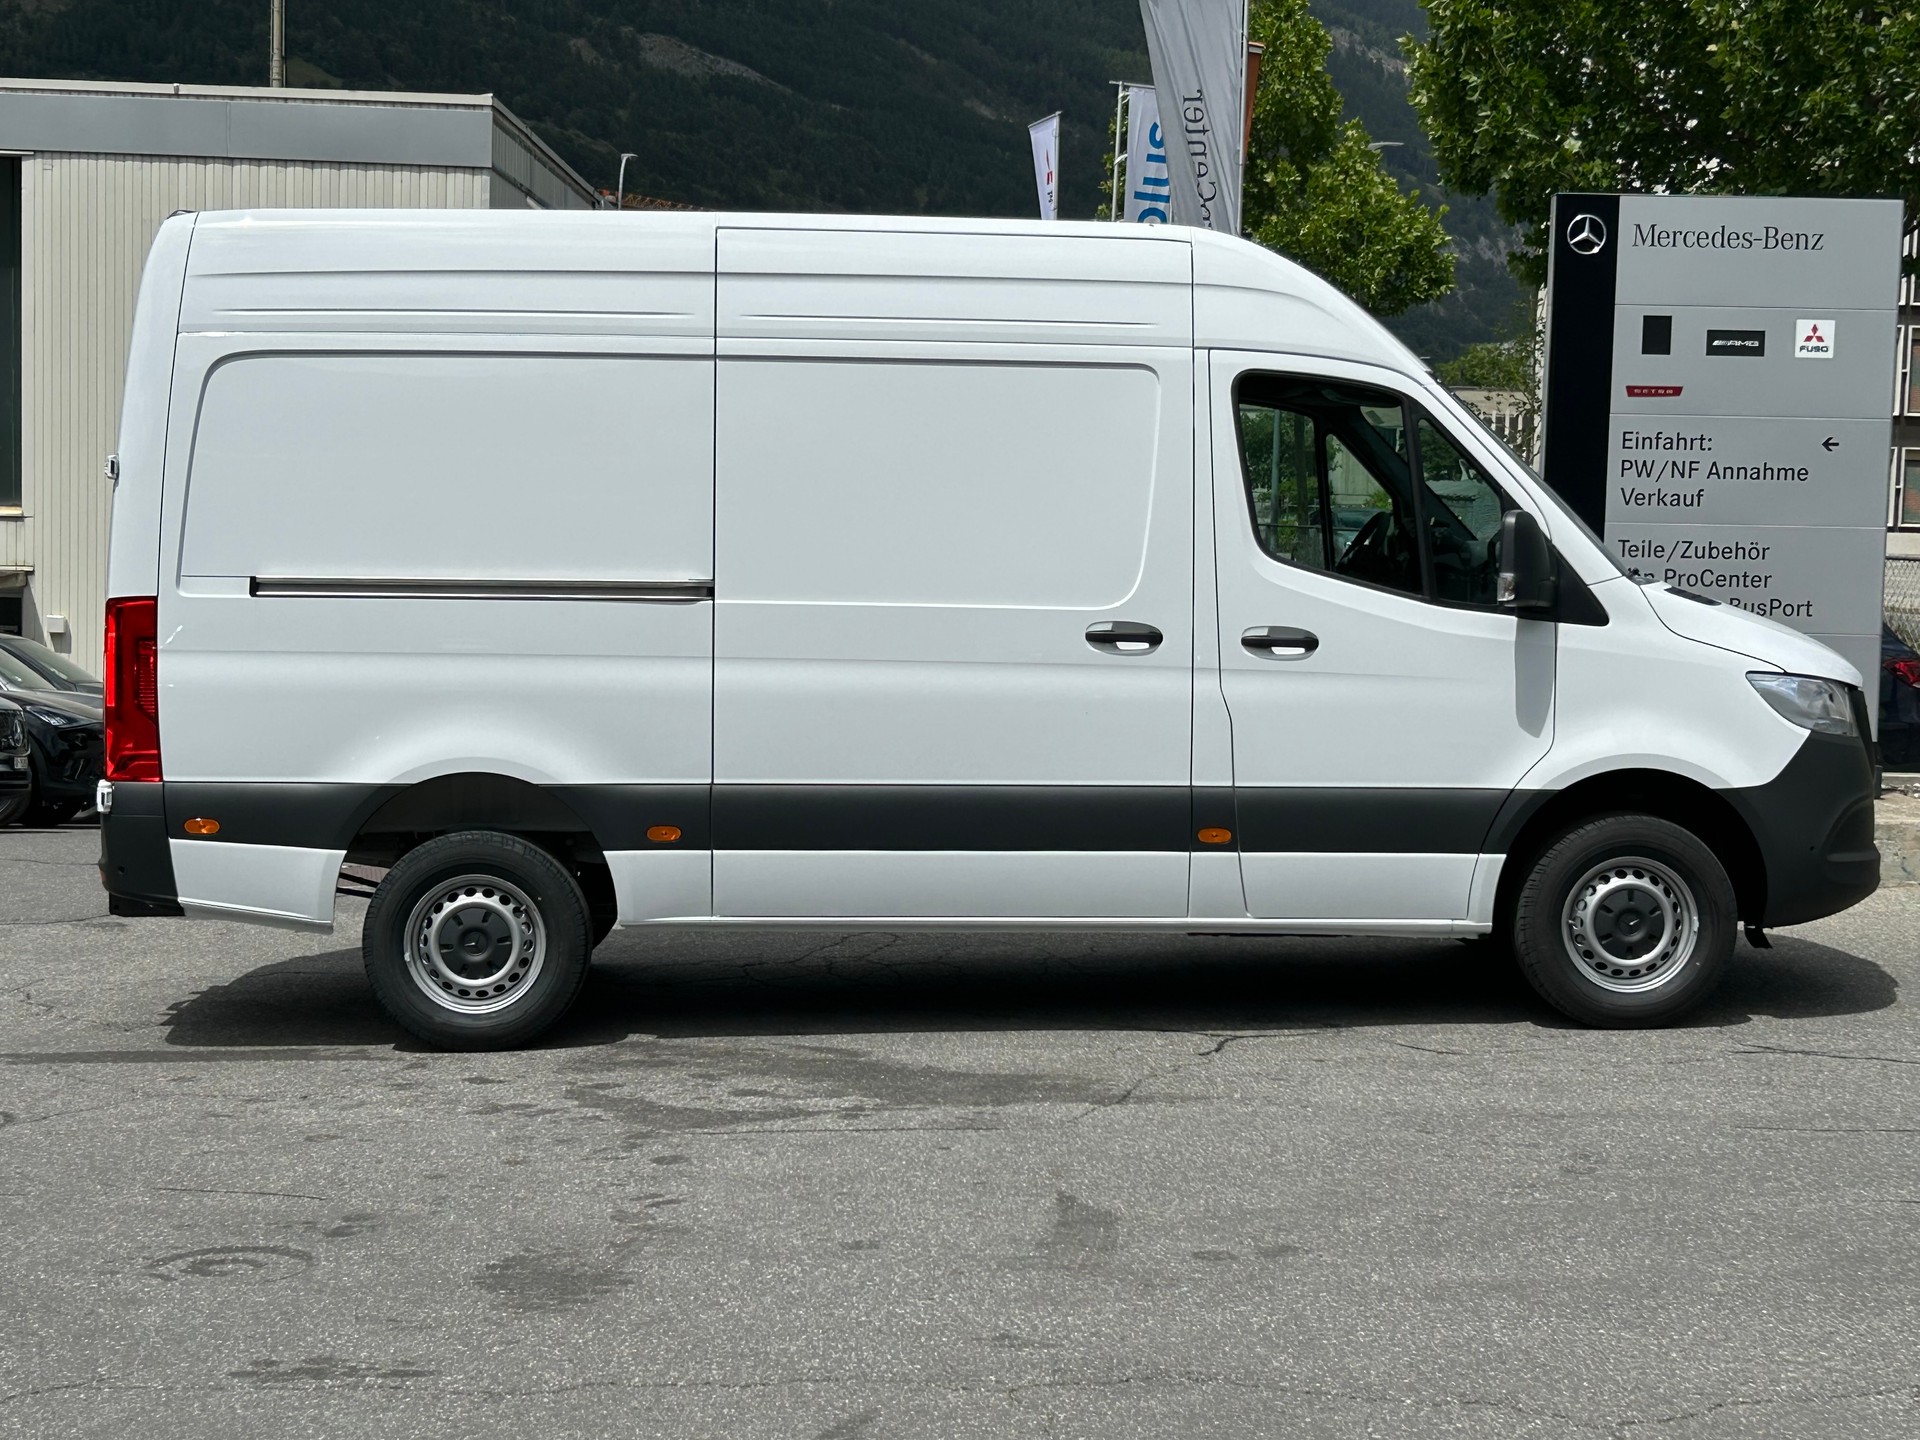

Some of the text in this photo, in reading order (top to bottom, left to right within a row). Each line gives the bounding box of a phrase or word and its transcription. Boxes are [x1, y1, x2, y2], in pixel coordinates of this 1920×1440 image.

[1632, 223, 1825, 251] Mercedes-Benz
[1799, 345, 1829, 353] FUSO
[1621, 431, 1713, 451] Einfahrt:
[1620, 459, 1809, 482] PW/NF Annahme
[1620, 487, 1705, 507] Verkauf
[1618, 539, 1771, 563] Teile/Zubehör
[1664, 568, 1773, 589] ProCenter
[1729, 597, 1813, 617] BusPort
